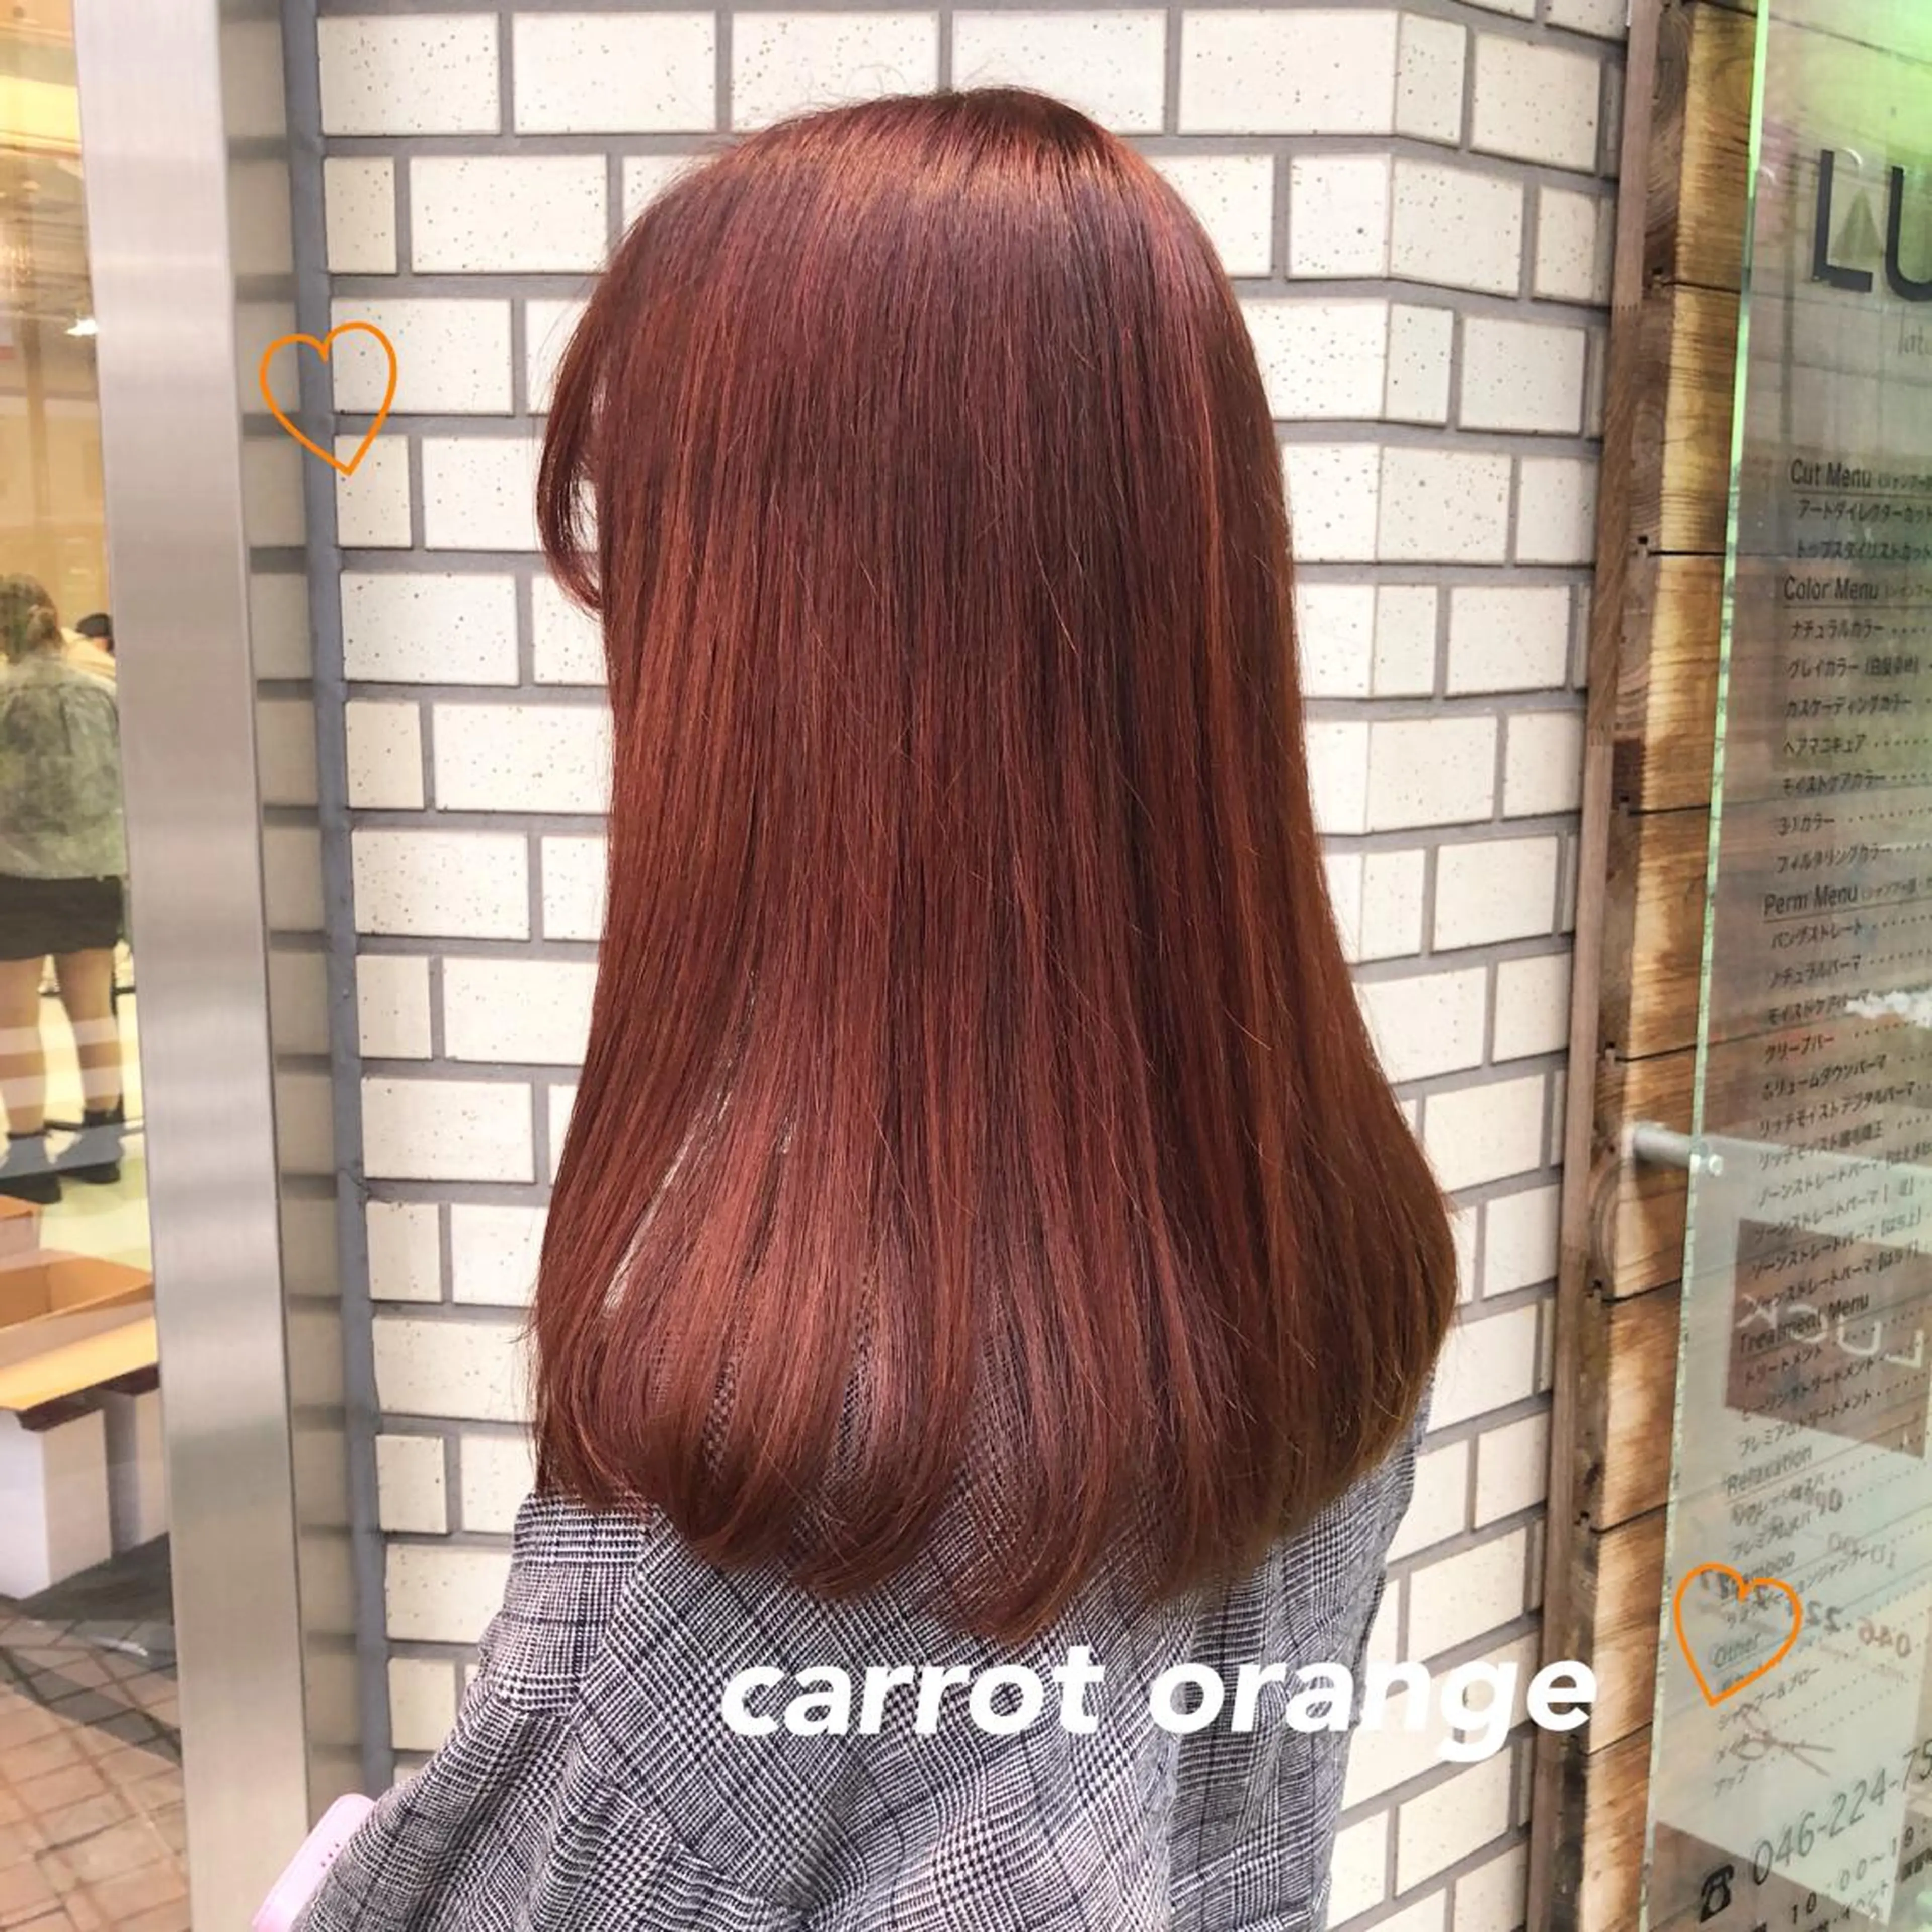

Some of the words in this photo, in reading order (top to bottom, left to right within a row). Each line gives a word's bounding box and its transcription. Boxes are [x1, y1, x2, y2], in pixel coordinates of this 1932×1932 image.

[1790, 458, 1822, 487] Cut
[1826, 461, 1872, 489] Menu
[1784, 574, 1831, 601] Color
[1834, 577, 1879, 600] Menu
[1763, 893, 1809, 917] Perm
[1813, 884, 1858, 907] Menu
